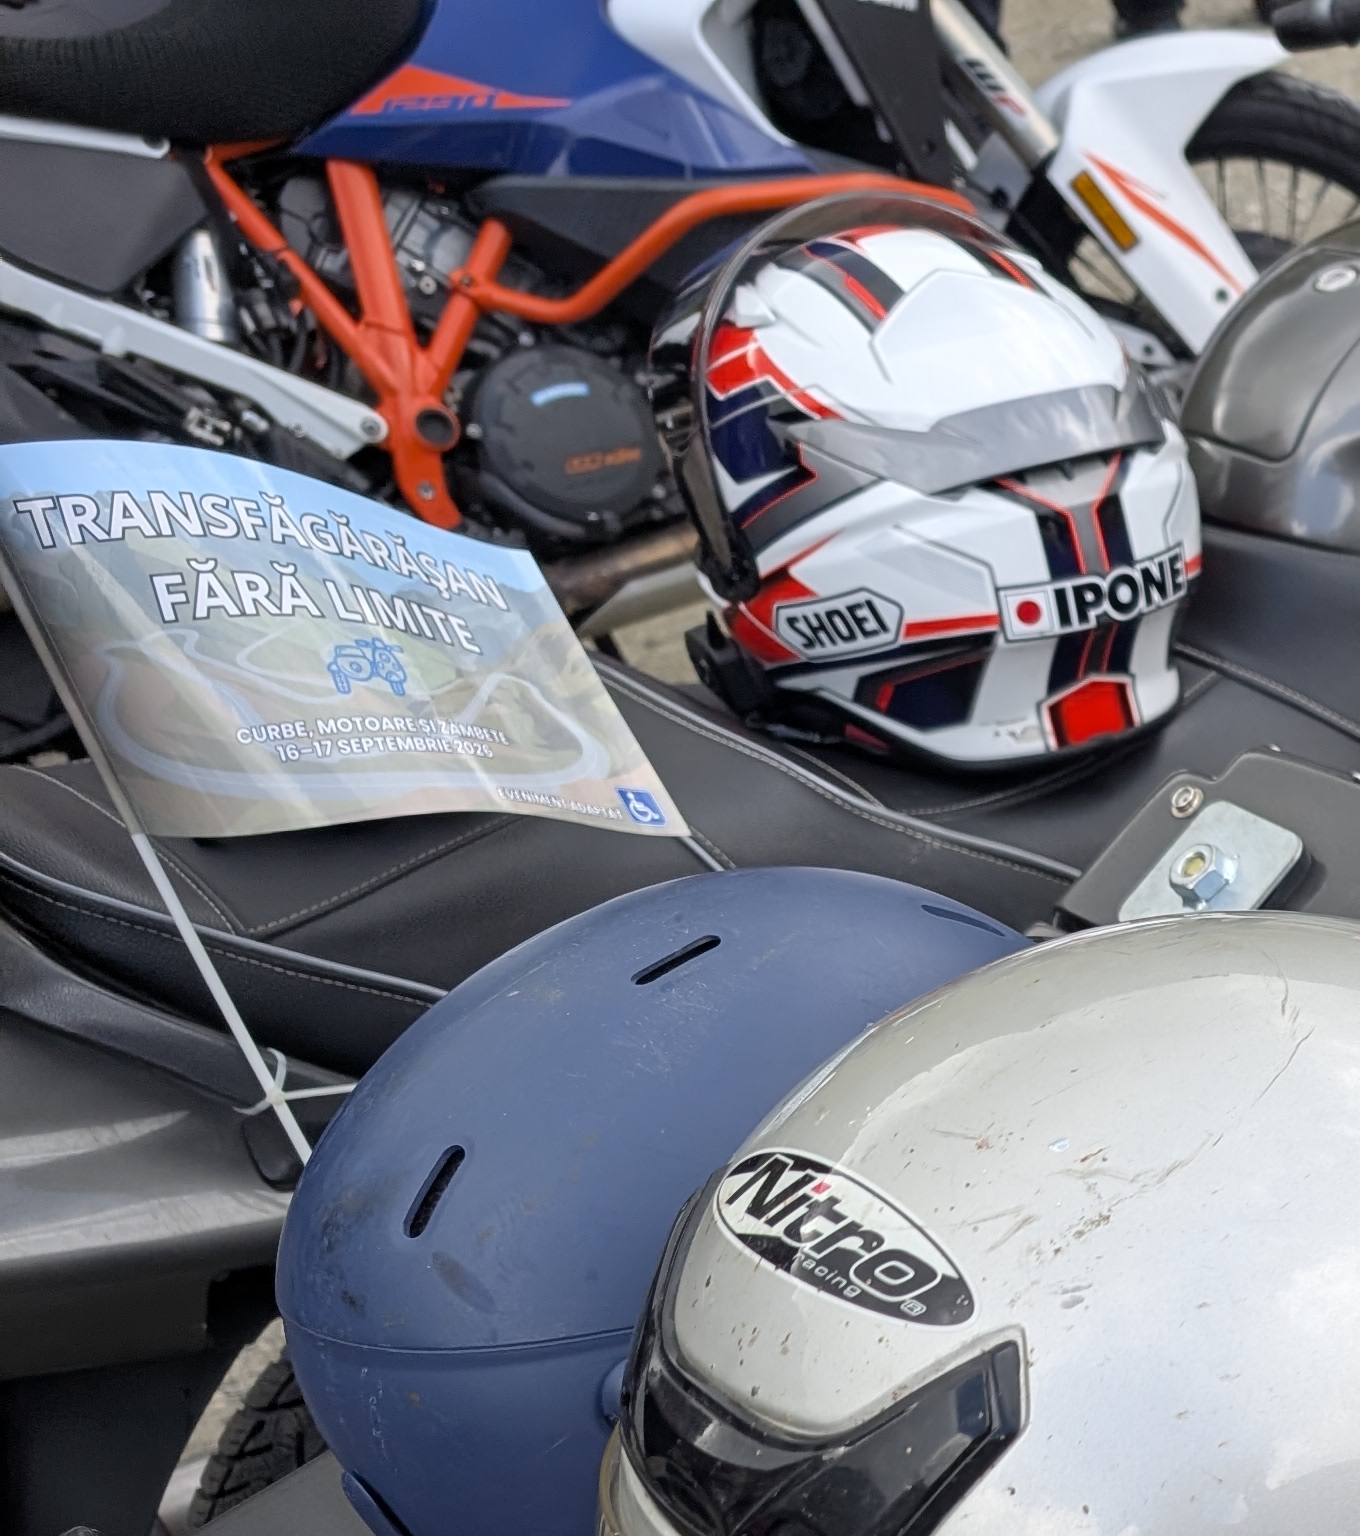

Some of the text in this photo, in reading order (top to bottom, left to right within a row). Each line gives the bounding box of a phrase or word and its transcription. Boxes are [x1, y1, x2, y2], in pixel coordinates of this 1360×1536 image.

[150, 558, 483, 656] FĂRĂ LIMITE
[1053, 549, 1187, 628] IPONE
[785, 599, 890, 650] SHOEI
[236, 720, 314, 745] CURBE,
[315, 715, 417, 736] MOTOARE
[337, 735, 453, 756] SEPTEMBRIE
[724, 1153, 943, 1301] Nitro
[792, 1251, 862, 1299] racing
